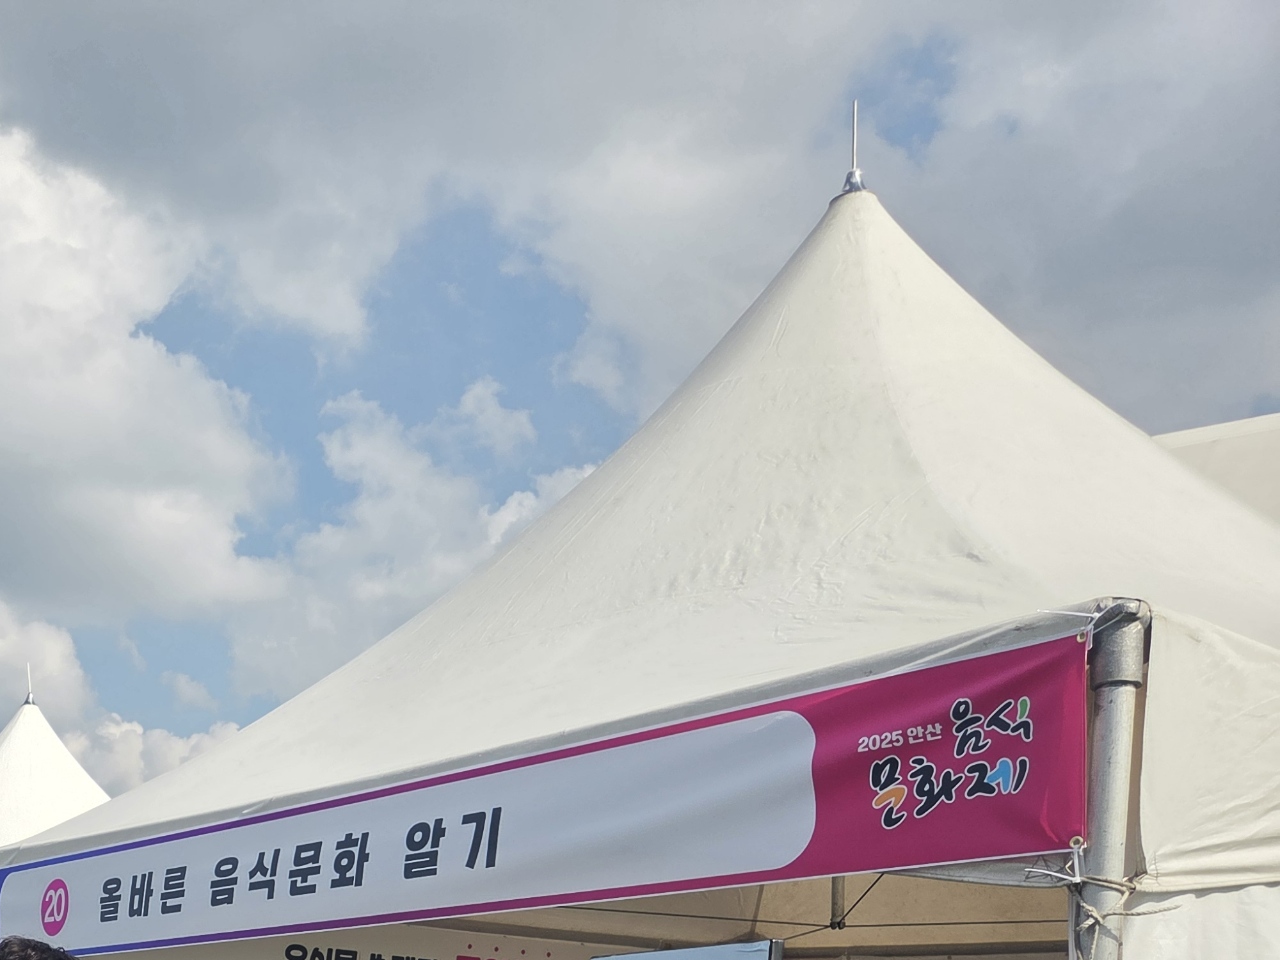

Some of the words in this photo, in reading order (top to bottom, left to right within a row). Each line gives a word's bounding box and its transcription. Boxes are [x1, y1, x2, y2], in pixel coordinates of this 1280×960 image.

[857, 730, 903, 752] 2025
[907, 723, 942, 744] 안산
[950, 696, 1033, 758] 음식
[870, 755, 1029, 829] 문화제
[100, 866, 187, 923] 올바른
[210, 832, 370, 906] 음식문화
[403, 807, 502, 879] 알기
[44, 889, 65, 923] 20
